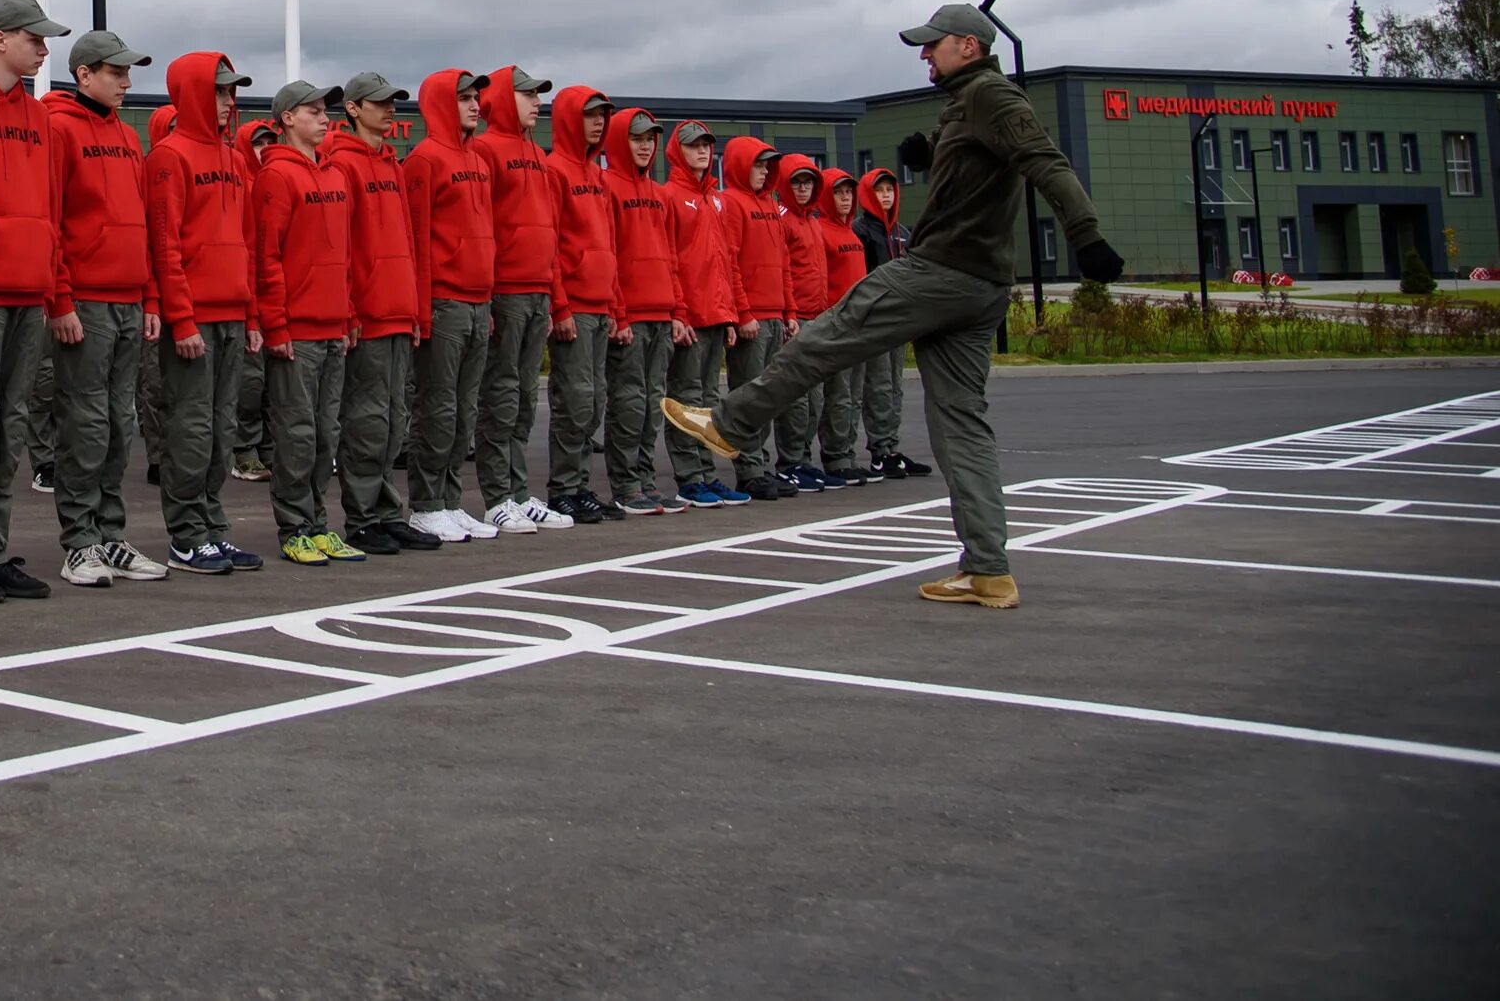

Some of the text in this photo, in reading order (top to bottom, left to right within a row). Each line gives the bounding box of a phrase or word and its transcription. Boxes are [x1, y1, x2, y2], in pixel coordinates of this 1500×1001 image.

[1137, 94, 1338, 123] медицинский пункт
[82, 145, 140, 165] АВАНГА
